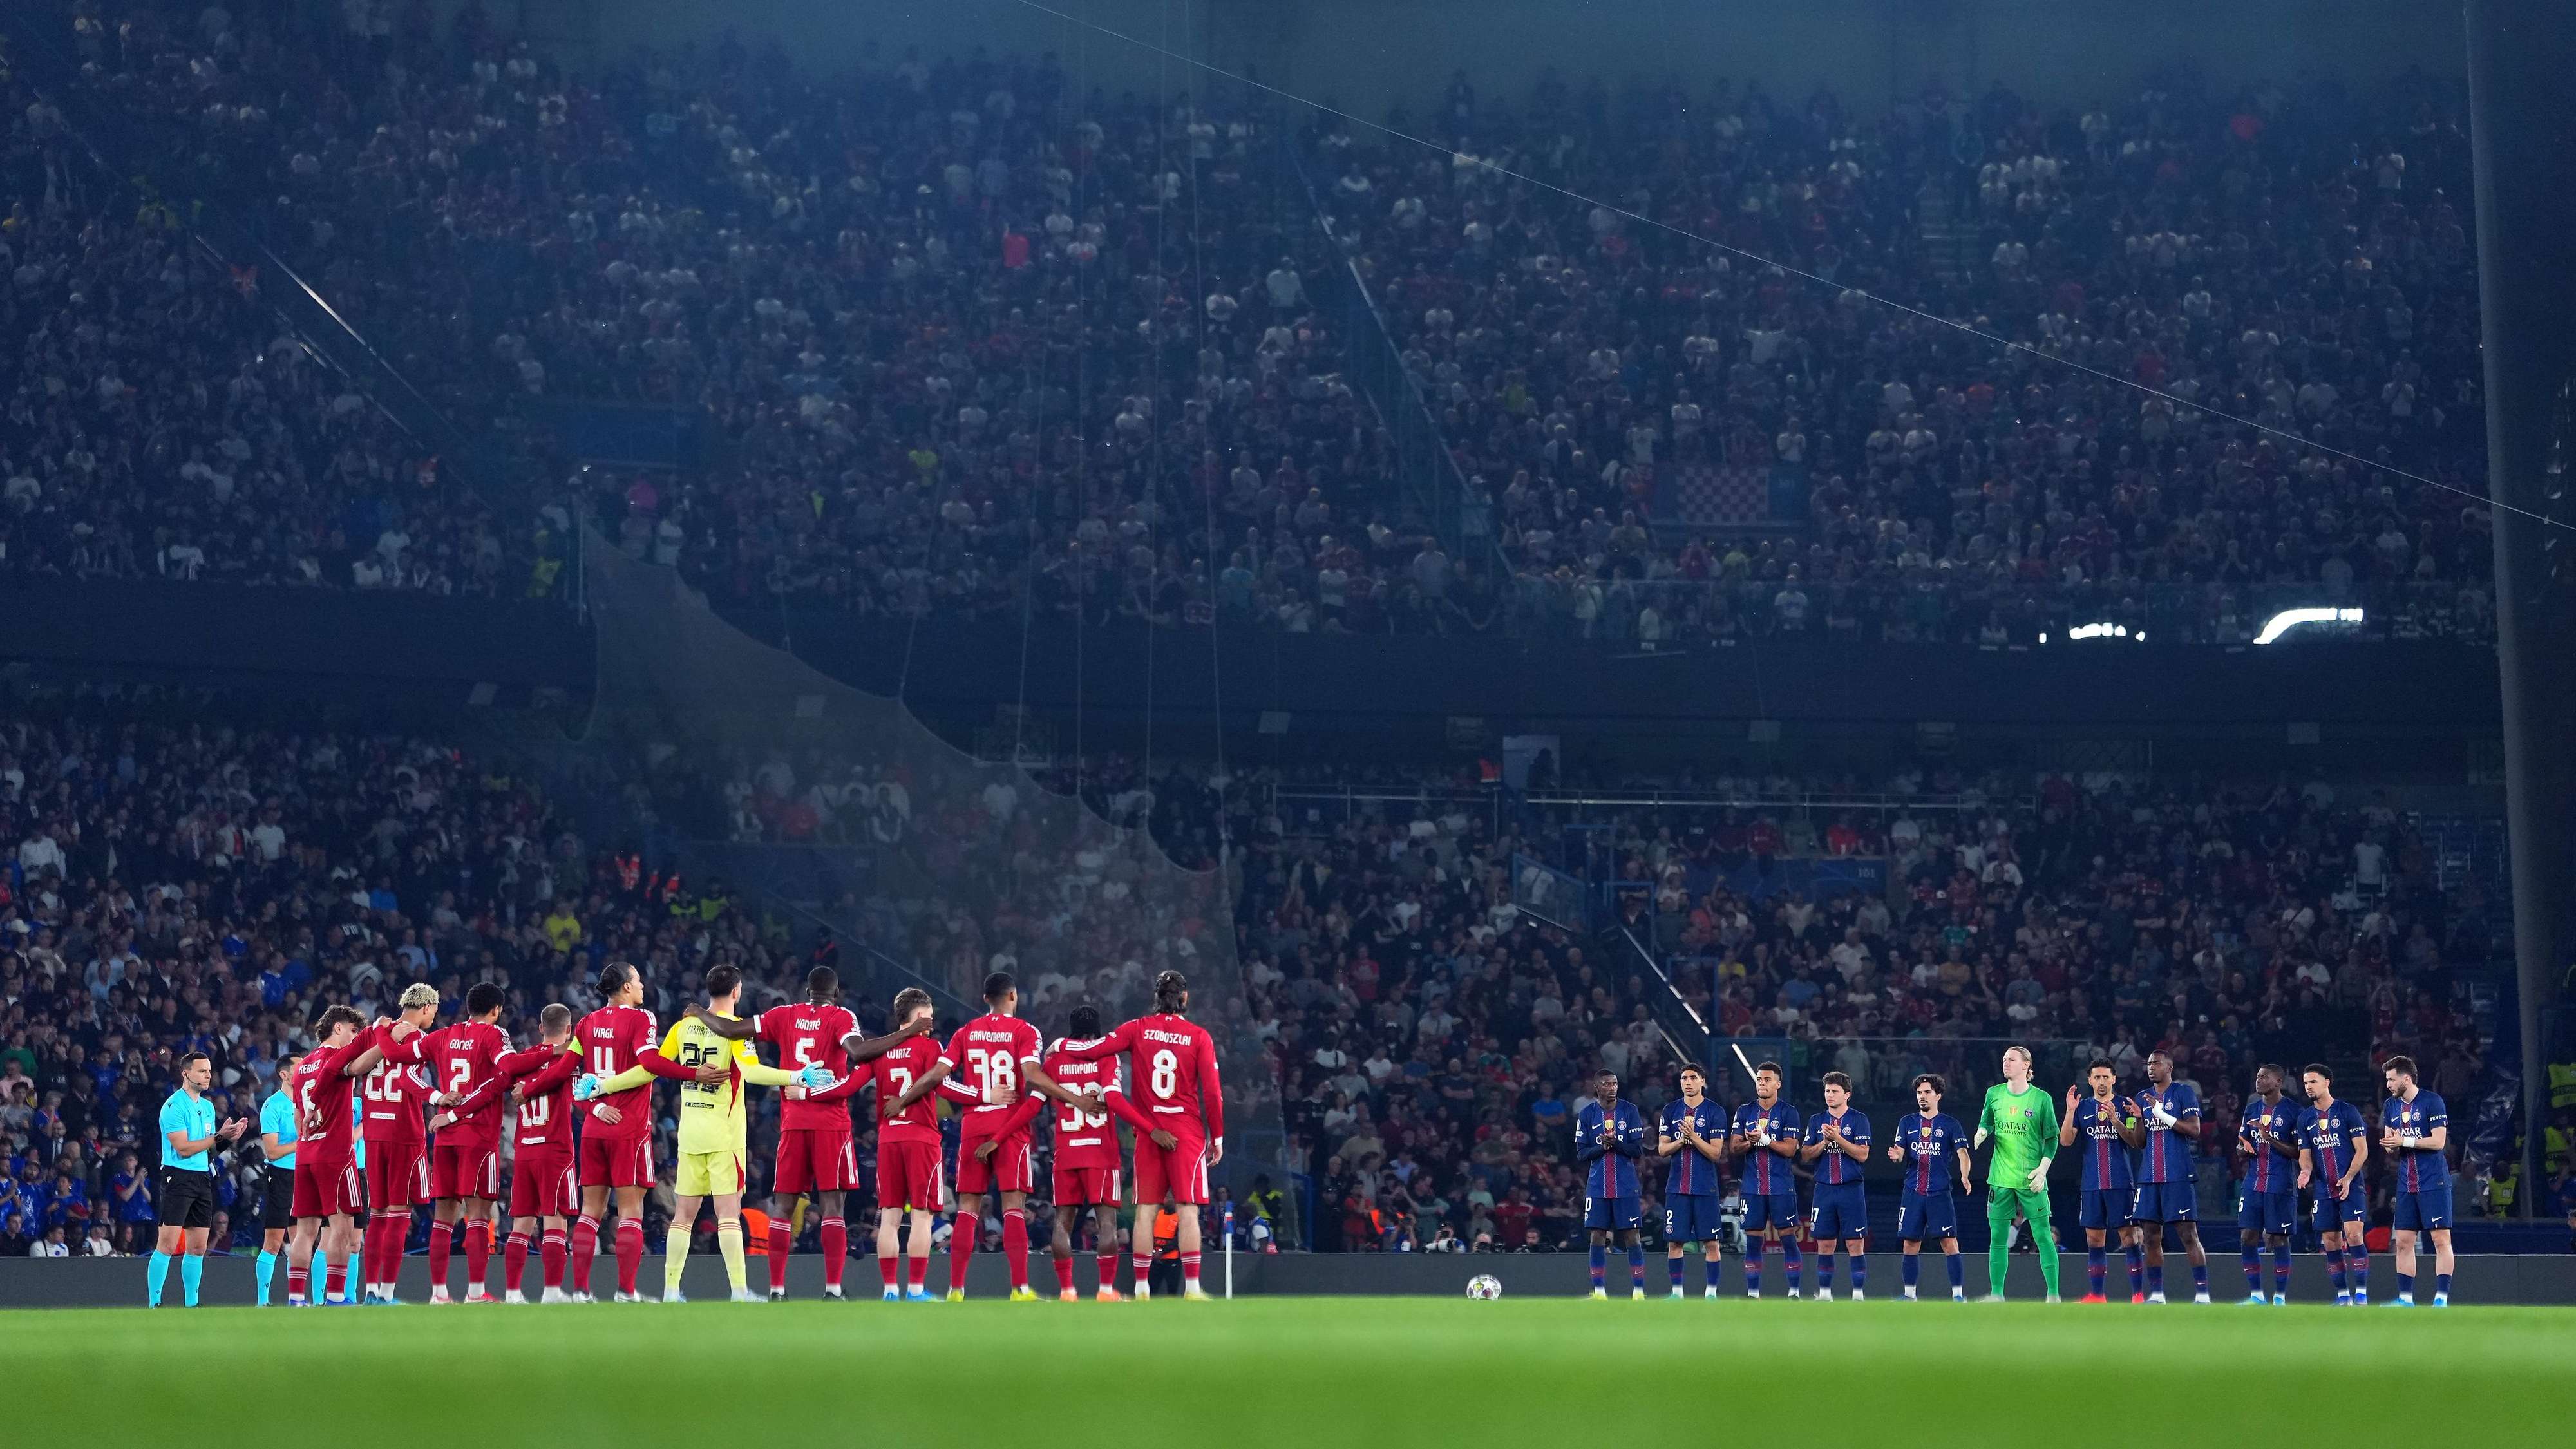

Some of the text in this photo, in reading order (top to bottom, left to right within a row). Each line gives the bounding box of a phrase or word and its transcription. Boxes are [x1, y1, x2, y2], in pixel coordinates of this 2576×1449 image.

[593, 1027, 614, 1039] VIRGIL
[1144, 1029, 1191, 1046] SZOBOSZLAI
[886, 1047, 912, 1059] WIRTZ
[594, 1046, 616, 1079] 4
[1059, 1062, 1098, 1075] FRIMPONG
[365, 1059, 402, 1102] 22
[968, 1049, 1016, 1103] 38
[1151, 1049, 1177, 1099] 8
[890, 1067, 913, 1117] 7
[1998, 1122, 2027, 1132] QATAR
[2145, 1117, 2167, 1127] QATA
[2087, 1126, 2117, 1136] QATAR
[2401, 1127, 2422, 1136] ATAR
[2313, 1133, 2340, 1145] QATAR
[2318, 1141, 2341, 1150] AIRWAYS
[1911, 1141, 1940, 1151] QATAR
[1740, 1199, 1748, 1214] 14
[2238, 1197, 2245, 1213] 5
[2313, 1200, 2318, 1214] 3
[1666, 1209, 1673, 1225] 2
